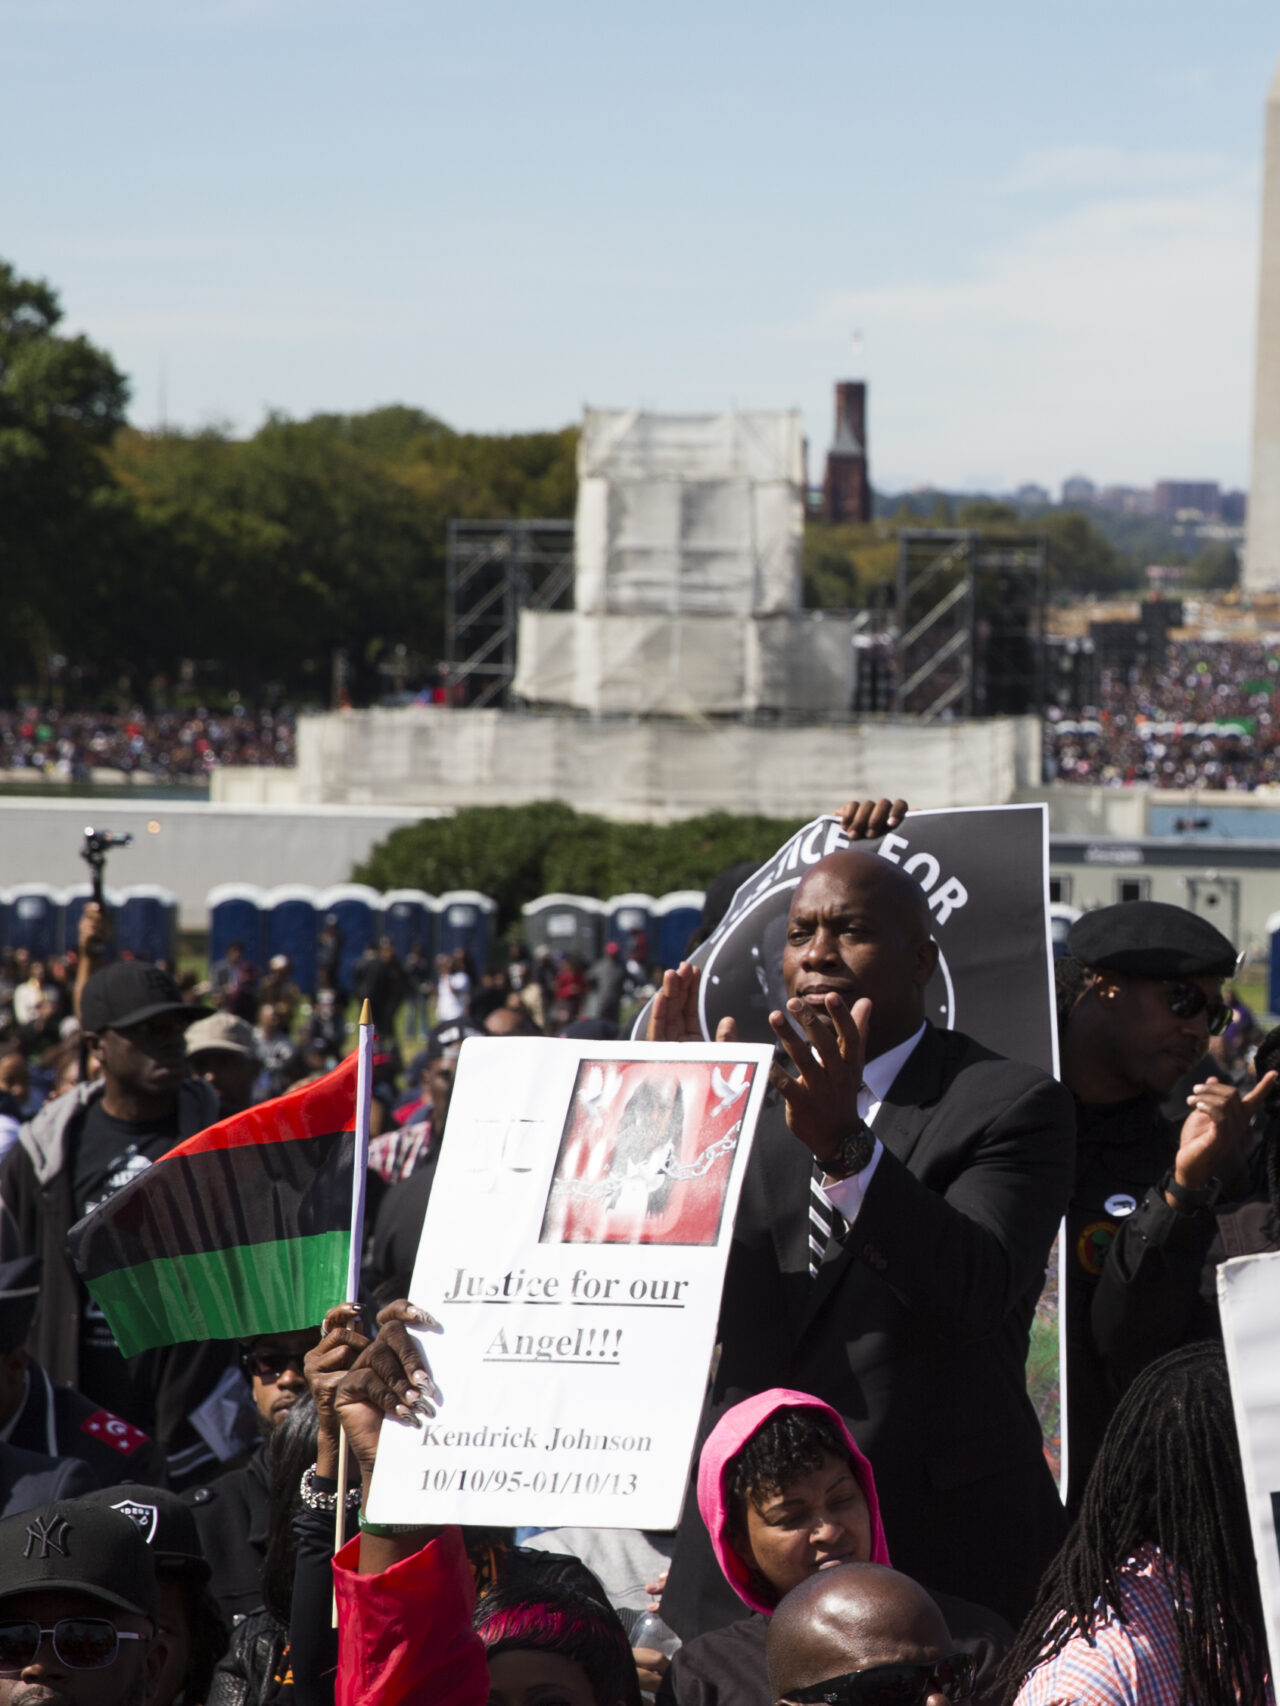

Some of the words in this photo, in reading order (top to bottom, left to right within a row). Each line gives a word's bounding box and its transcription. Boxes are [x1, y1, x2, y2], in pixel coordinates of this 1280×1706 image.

[877, 833, 969, 926] FOR
[444, 1267, 560, 1301] Justice
[571, 1269, 620, 1299] for
[629, 1278, 689, 1302] our
[485, 1326, 623, 1362] Angel!!!
[420, 1424, 539, 1450] Kendrick
[544, 1426, 652, 1452] Johnson
[419, 1467, 638, 1496] 10/10/95-01/10/13
[23, 1513, 74, 1560] NY
